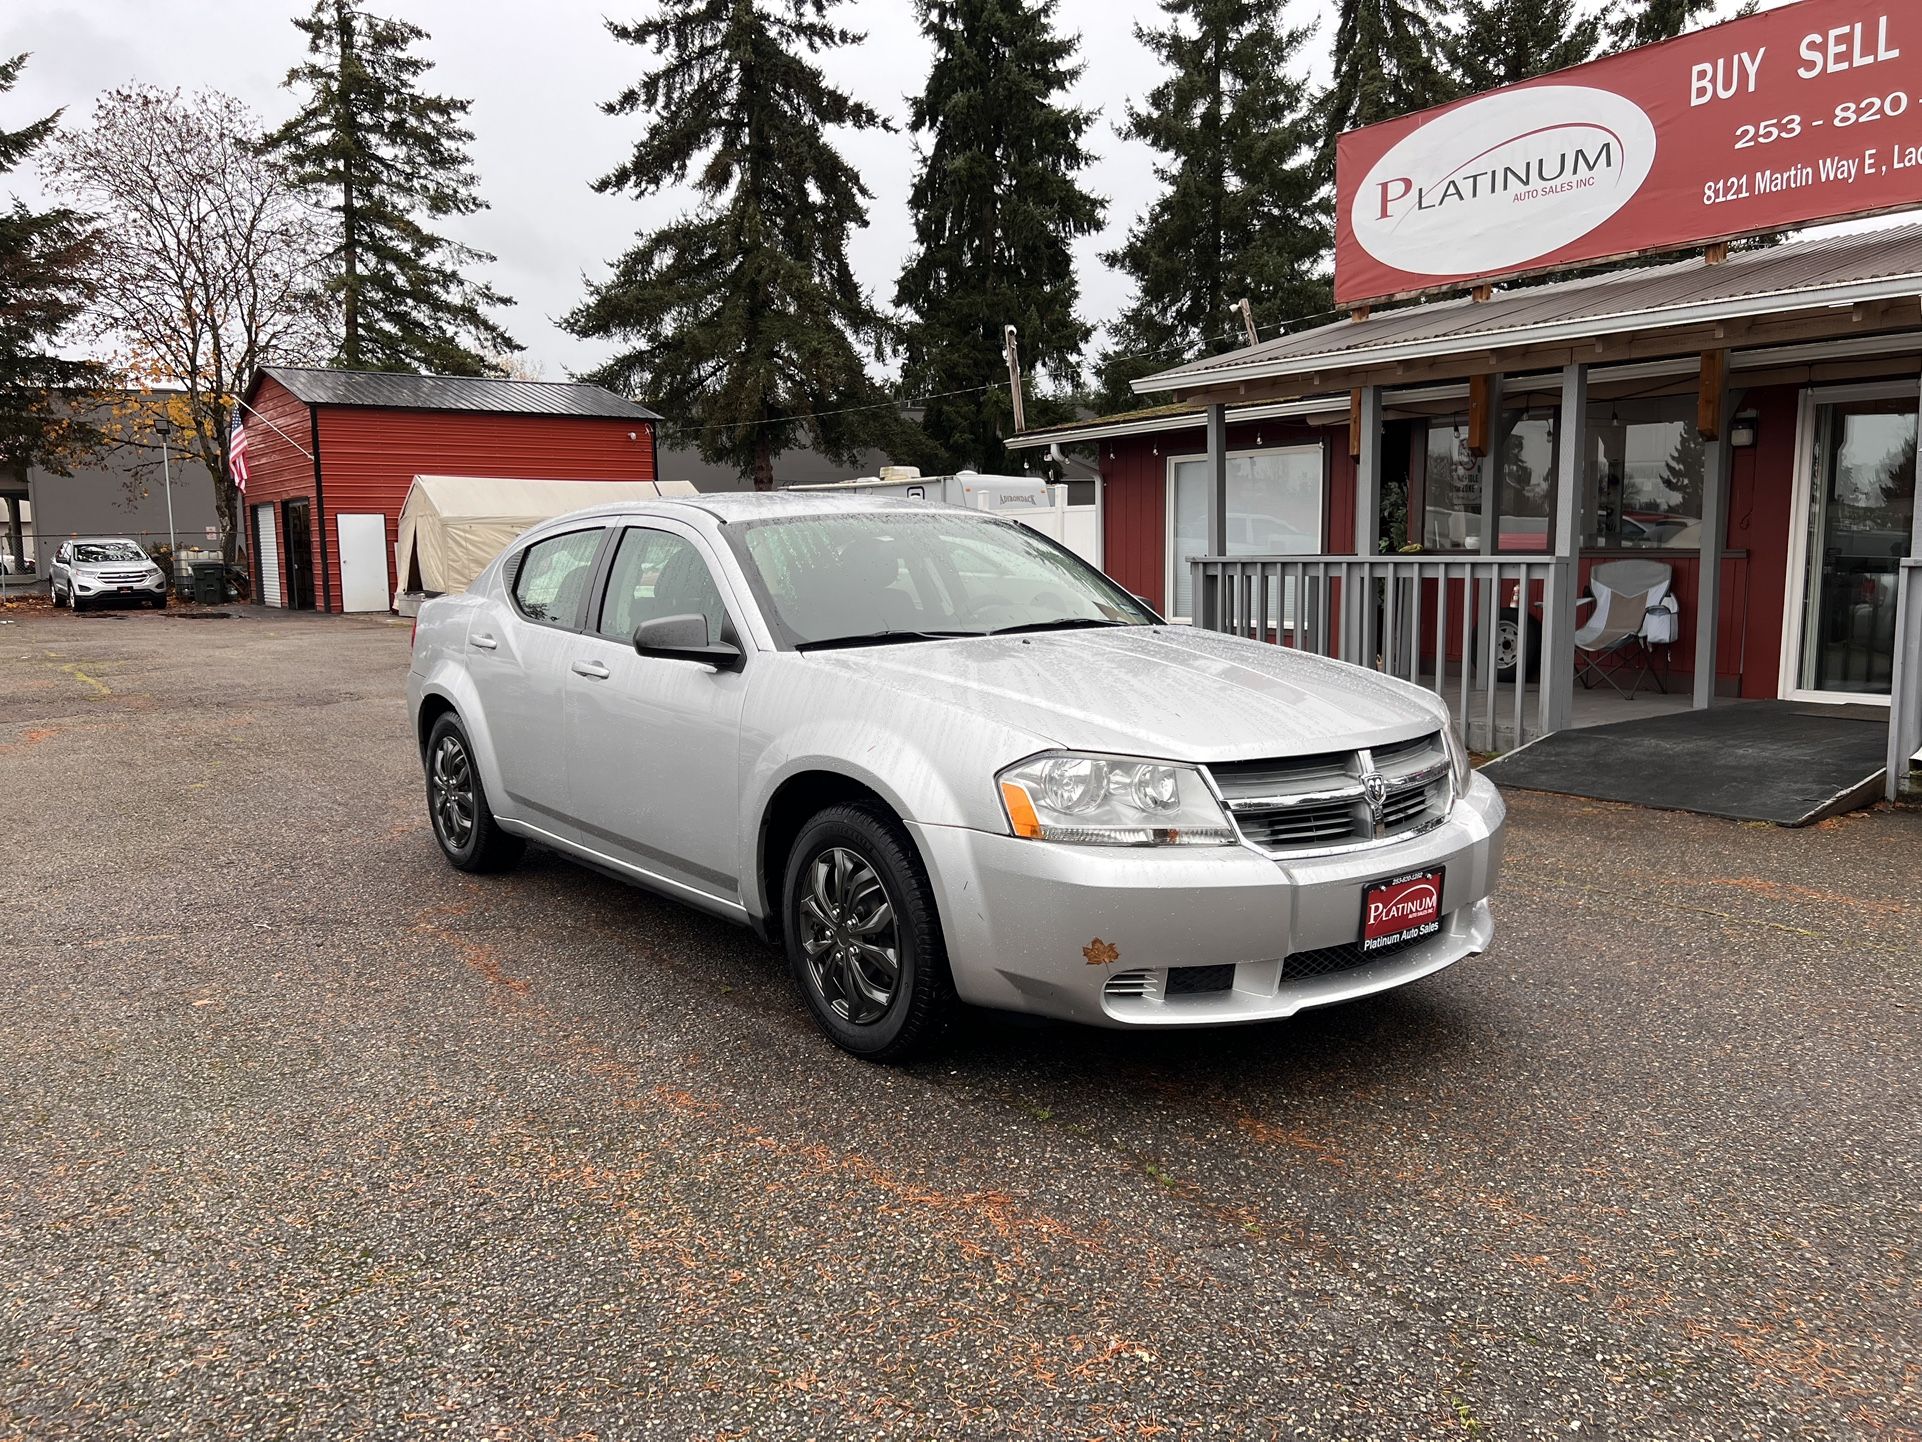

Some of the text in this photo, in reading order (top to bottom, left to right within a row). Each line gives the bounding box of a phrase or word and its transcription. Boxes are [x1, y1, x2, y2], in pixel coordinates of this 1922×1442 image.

[1690, 15, 1900, 107] BUY SELL
[1734, 114, 1801, 150] 253
[1833, 91, 1908, 127] 820
[1375, 142, 1612, 221] PLATINUM
[1512, 176, 1596, 203] AUTO SALES INC
[1703, 174, 1750, 205] 8121
[1754, 163, 1813, 195] Martin
[1818, 155, 1859, 184] Way
[1000, 494, 1037, 505] ADIRONDACK
[1368, 896, 1436, 924] PLATINUM
[1364, 922, 1439, 951] Platinum Auto Sales
